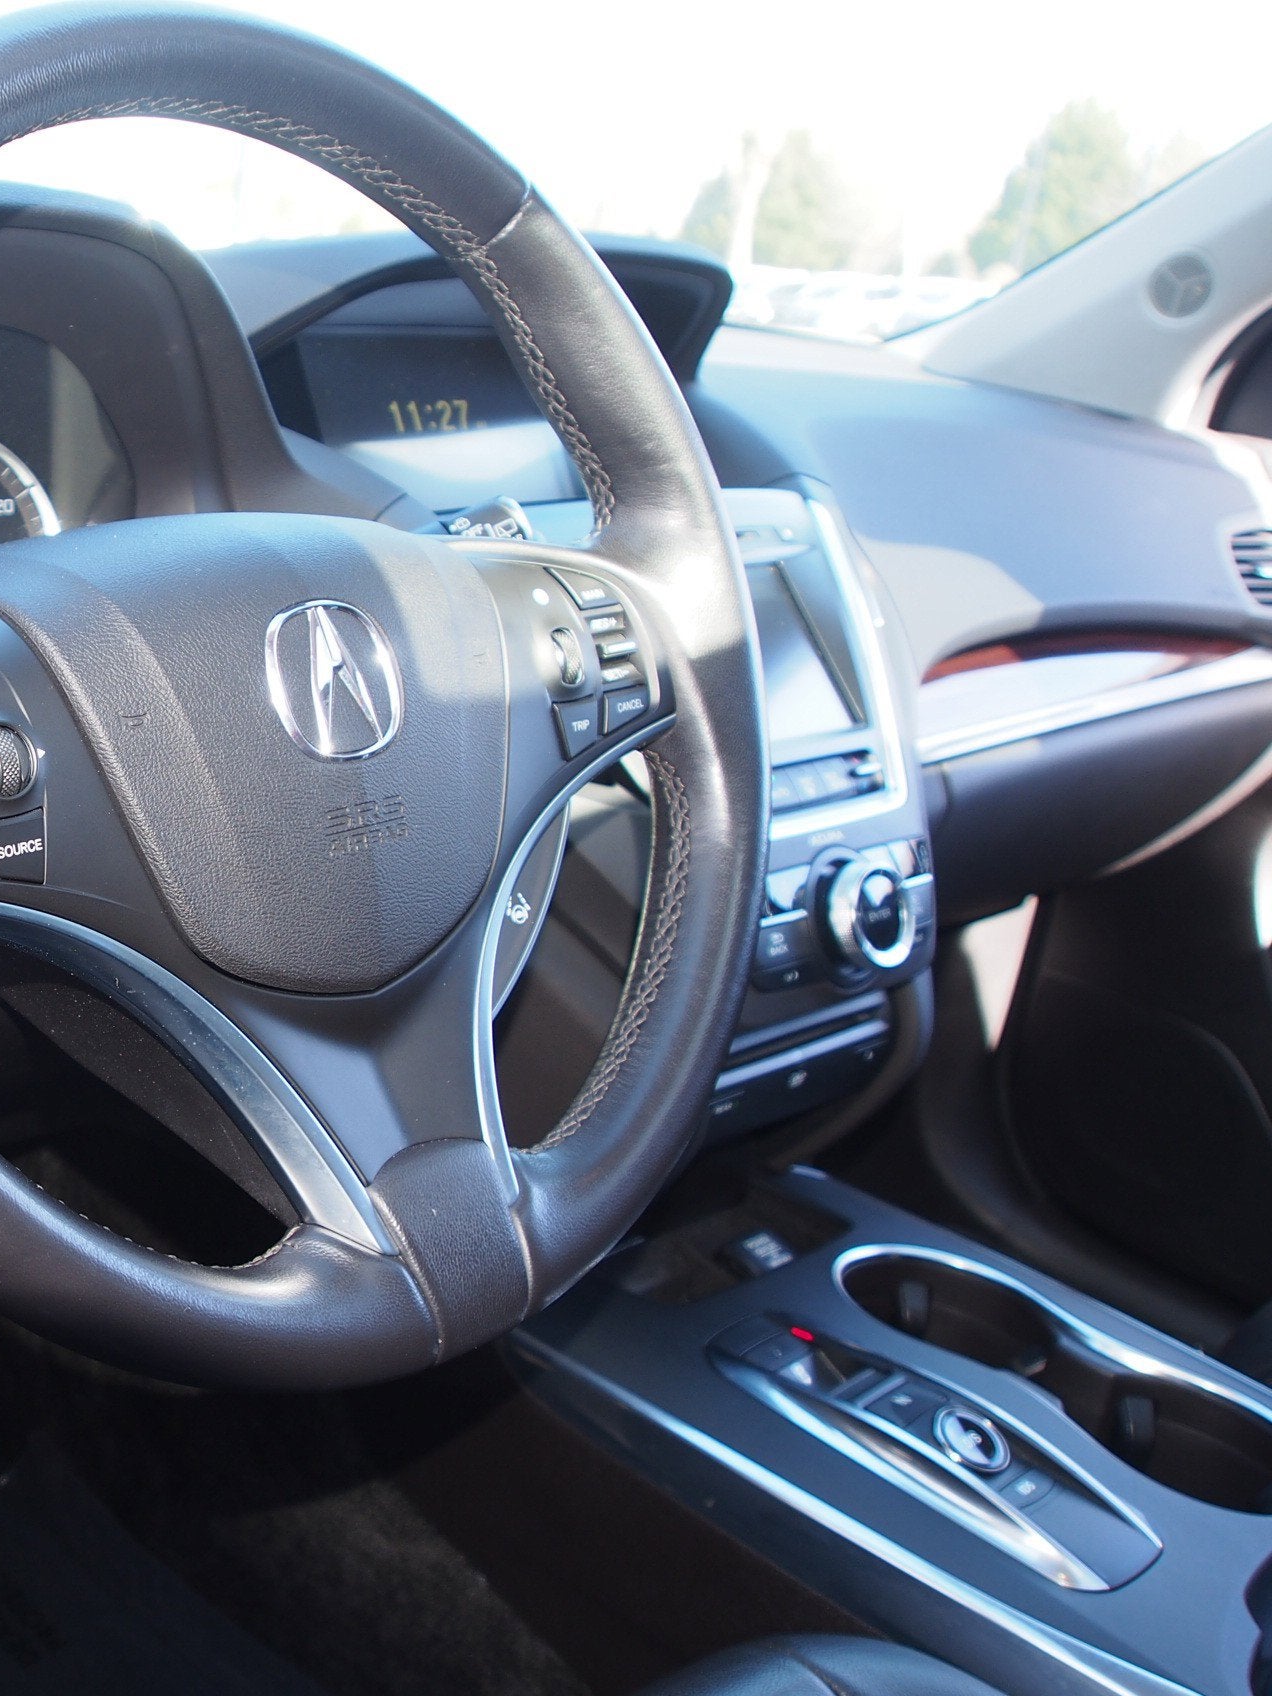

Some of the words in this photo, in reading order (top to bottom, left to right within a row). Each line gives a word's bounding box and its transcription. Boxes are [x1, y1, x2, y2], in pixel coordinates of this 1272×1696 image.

[388, 400, 469, 432] 11:27
[617, 698, 645, 713] CANCEL
[571, 718, 590, 733] TRIP
[325, 794, 405, 829] SRS
[868, 907, 892, 923] ENTER
